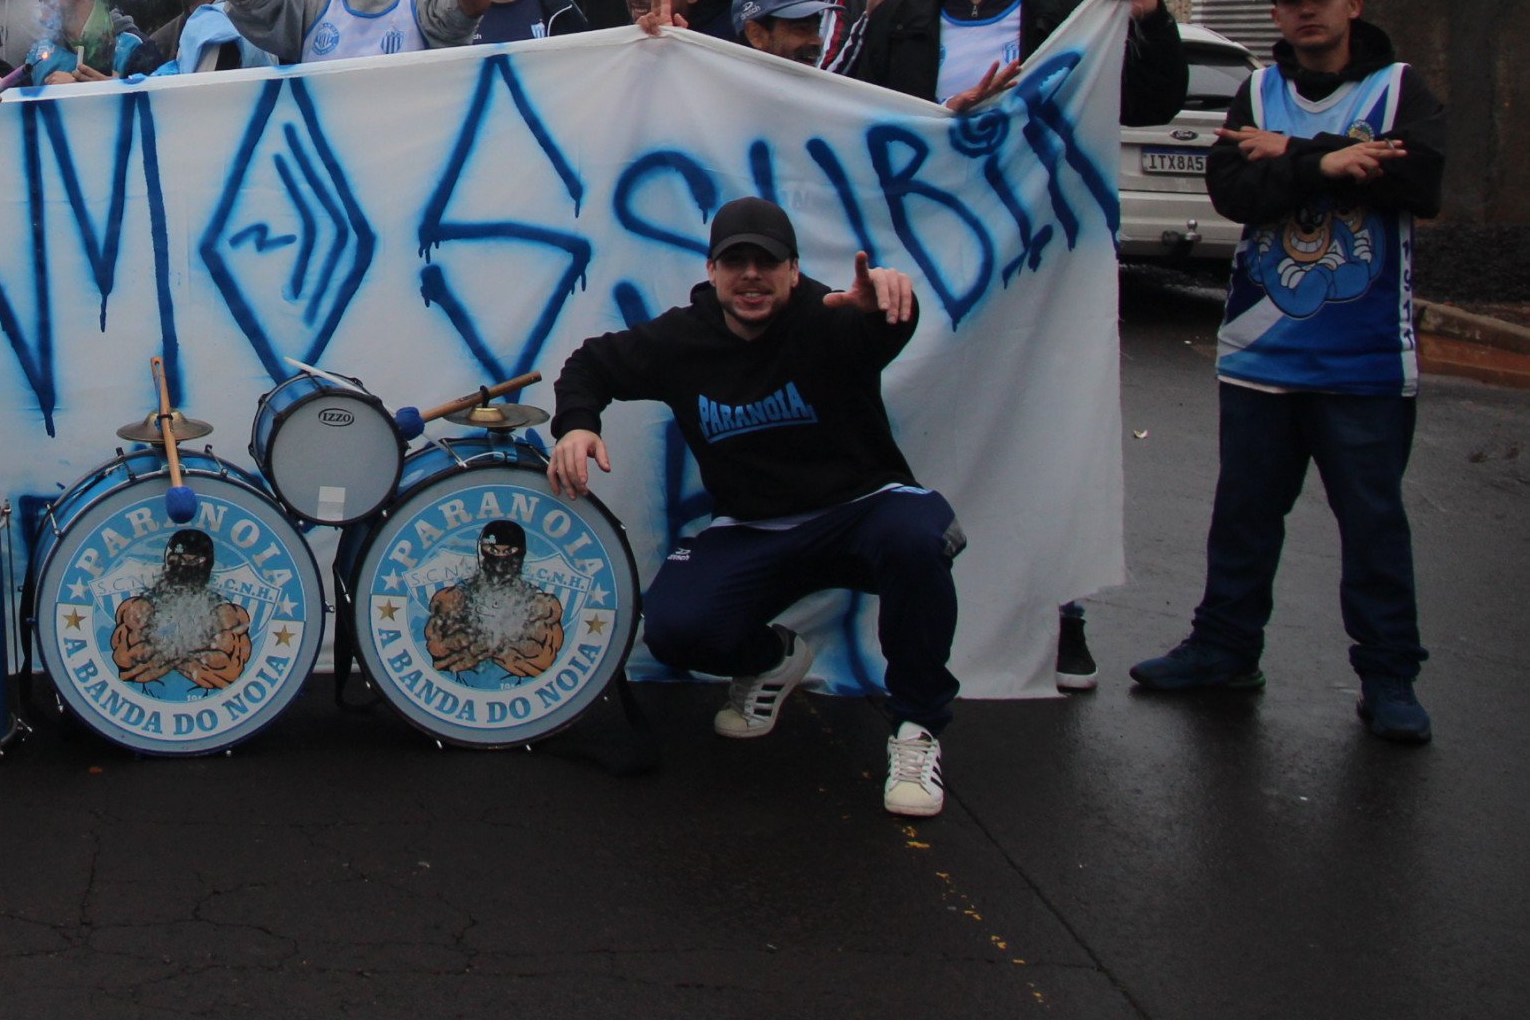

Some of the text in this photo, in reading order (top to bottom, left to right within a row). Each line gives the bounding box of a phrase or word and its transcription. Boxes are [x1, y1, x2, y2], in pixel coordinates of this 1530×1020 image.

[1149, 154, 1206, 171] ITX8A5
[322, 412, 352, 423] IZZO
[698, 381, 813, 439] PARANOIA
[388, 491, 605, 578] PARANOIA
[63, 637, 291, 736] A BANDA DO NOIA
[377, 627, 603, 724] A BANDA DO NOIA
